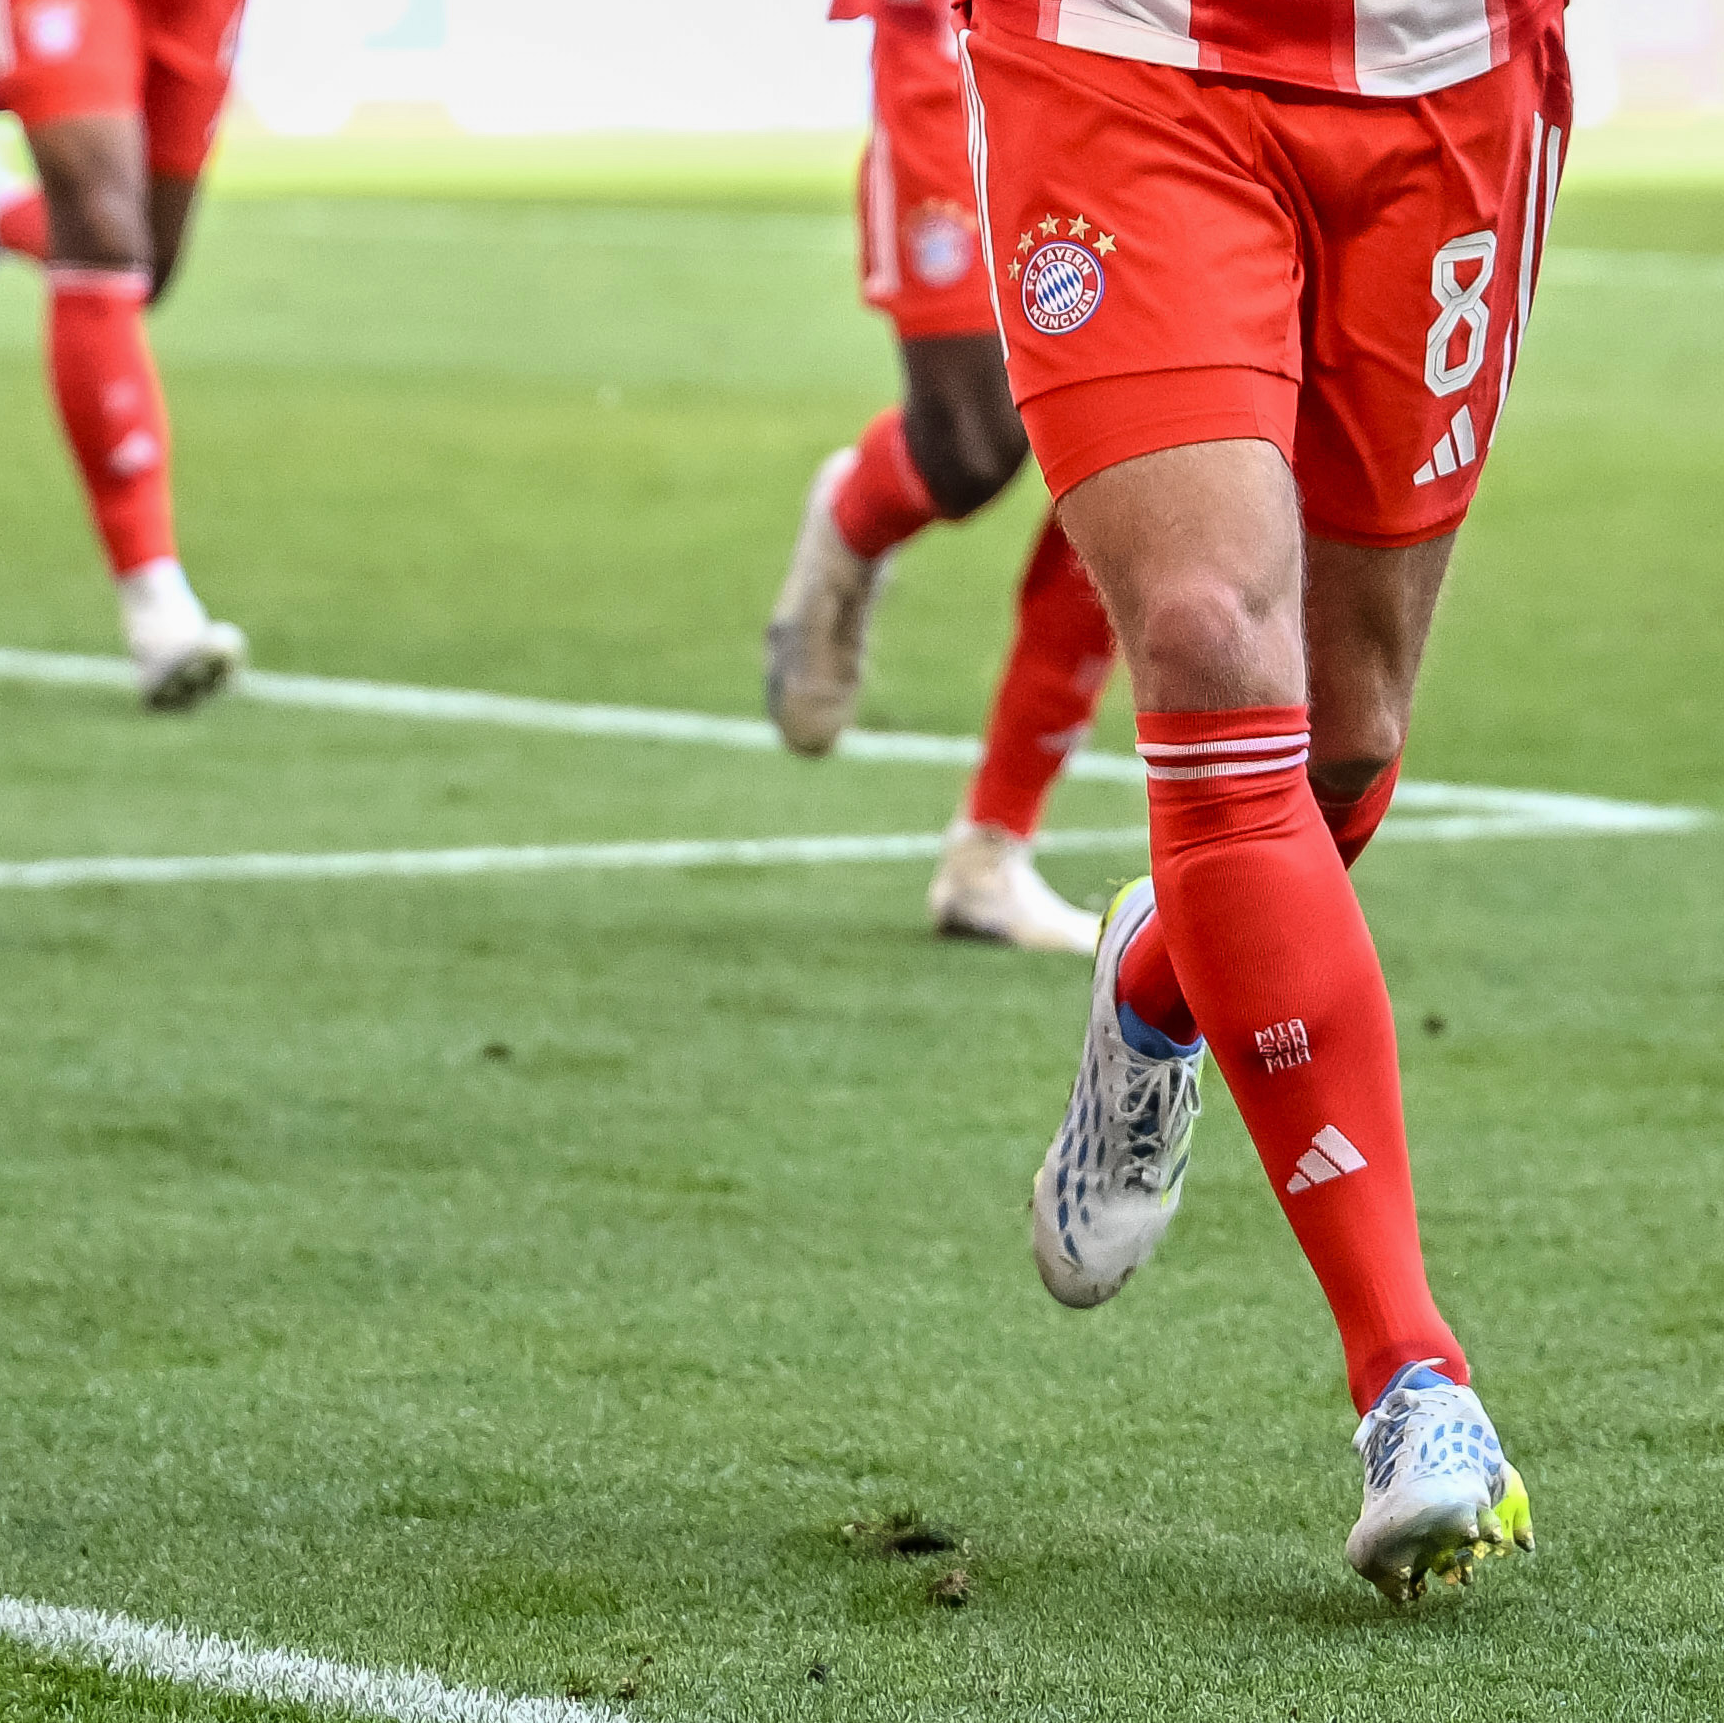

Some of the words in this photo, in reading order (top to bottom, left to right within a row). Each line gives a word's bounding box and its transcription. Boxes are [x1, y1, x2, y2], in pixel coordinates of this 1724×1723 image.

[1026, 268, 1038, 291] FC
[1035, 248, 1094, 277] BAYERN
[1425, 229, 1496, 397] 8
